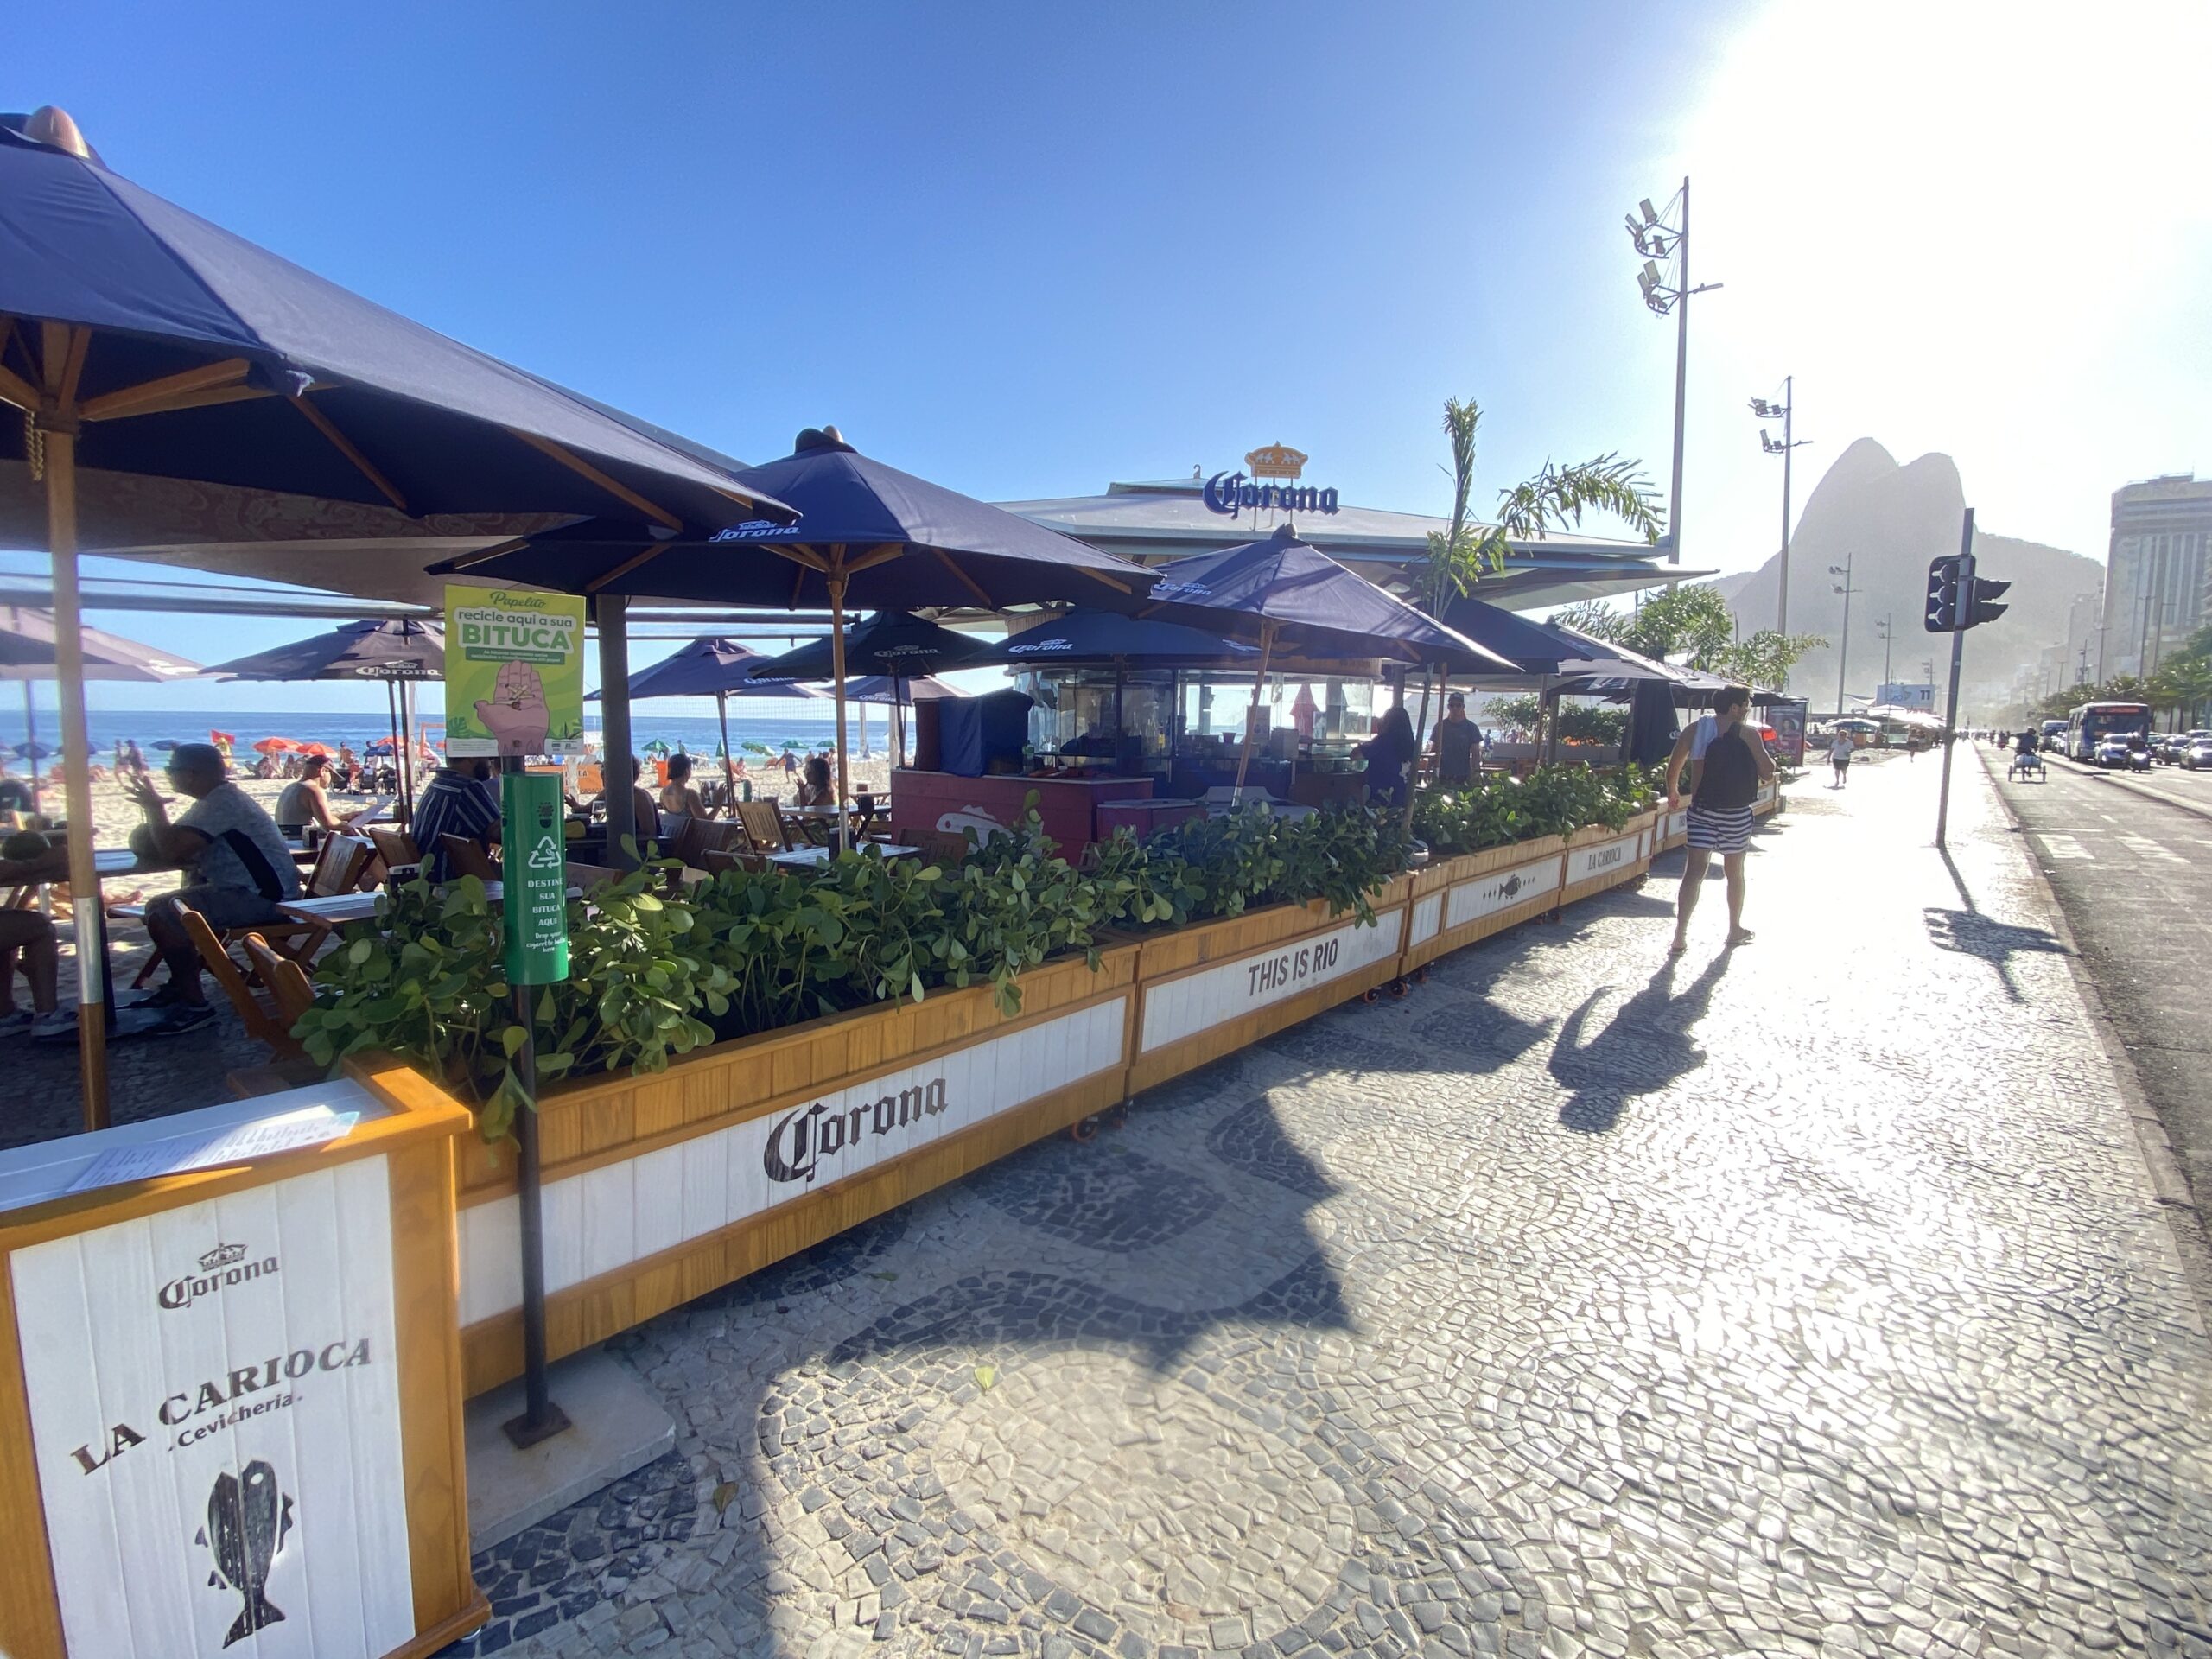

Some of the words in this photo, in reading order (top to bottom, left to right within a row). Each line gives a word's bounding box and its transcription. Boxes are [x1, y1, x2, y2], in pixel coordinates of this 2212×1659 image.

[1203, 470, 1340, 520] Corona
[1154, 582, 1212, 595] Corona
[490, 591, 546, 608] Papelito
[458, 610, 504, 623] recicle
[506, 614, 536, 626] aqui
[538, 618, 547, 626] a
[550, 619, 573, 627] sua
[462, 623, 569, 650] BITUCA
[1008, 644, 1073, 654] Corona
[355, 666, 442, 677] Corona
[1587, 853, 1596, 871] LA
[1597, 846, 1622, 868] CARIOCA
[527, 878, 563, 888] DESTINE
[539, 892, 556, 900] SUA
[532, 904, 561, 914] BITUCA
[538, 917, 557, 927] AQUI
[1248, 955, 1289, 997] THIS
[1292, 948, 1309, 982] IS
[1312, 938, 1338, 974] RIO
[763, 1077, 949, 1183] Corona
[158, 1256, 281, 1310] Corona
[70, 1422, 147, 1476] LA
[158, 1338, 372, 1426] CARIOCA
[176, 1392, 294, 1448] Cevicheria
